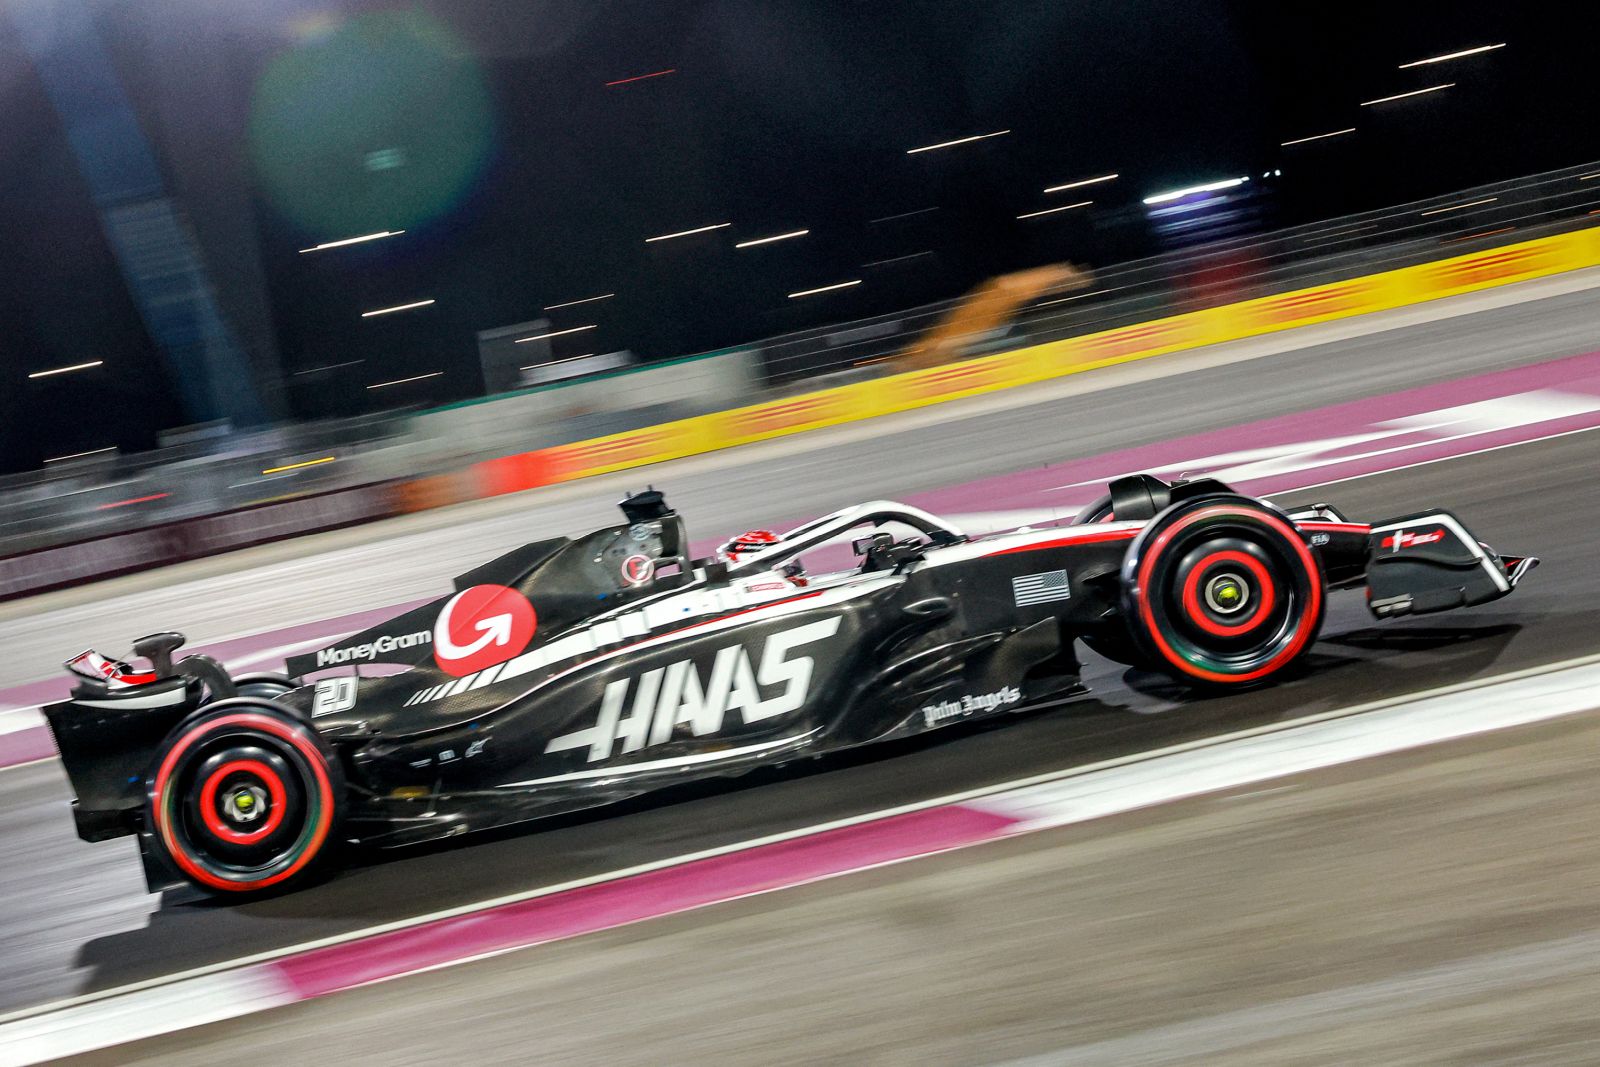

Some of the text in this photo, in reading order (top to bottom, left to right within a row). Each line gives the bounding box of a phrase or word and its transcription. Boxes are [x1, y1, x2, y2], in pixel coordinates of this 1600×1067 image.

[317, 630, 432, 667] MoneyGram
[311, 677, 359, 718] 20
[544, 616, 842, 762] HAAS
